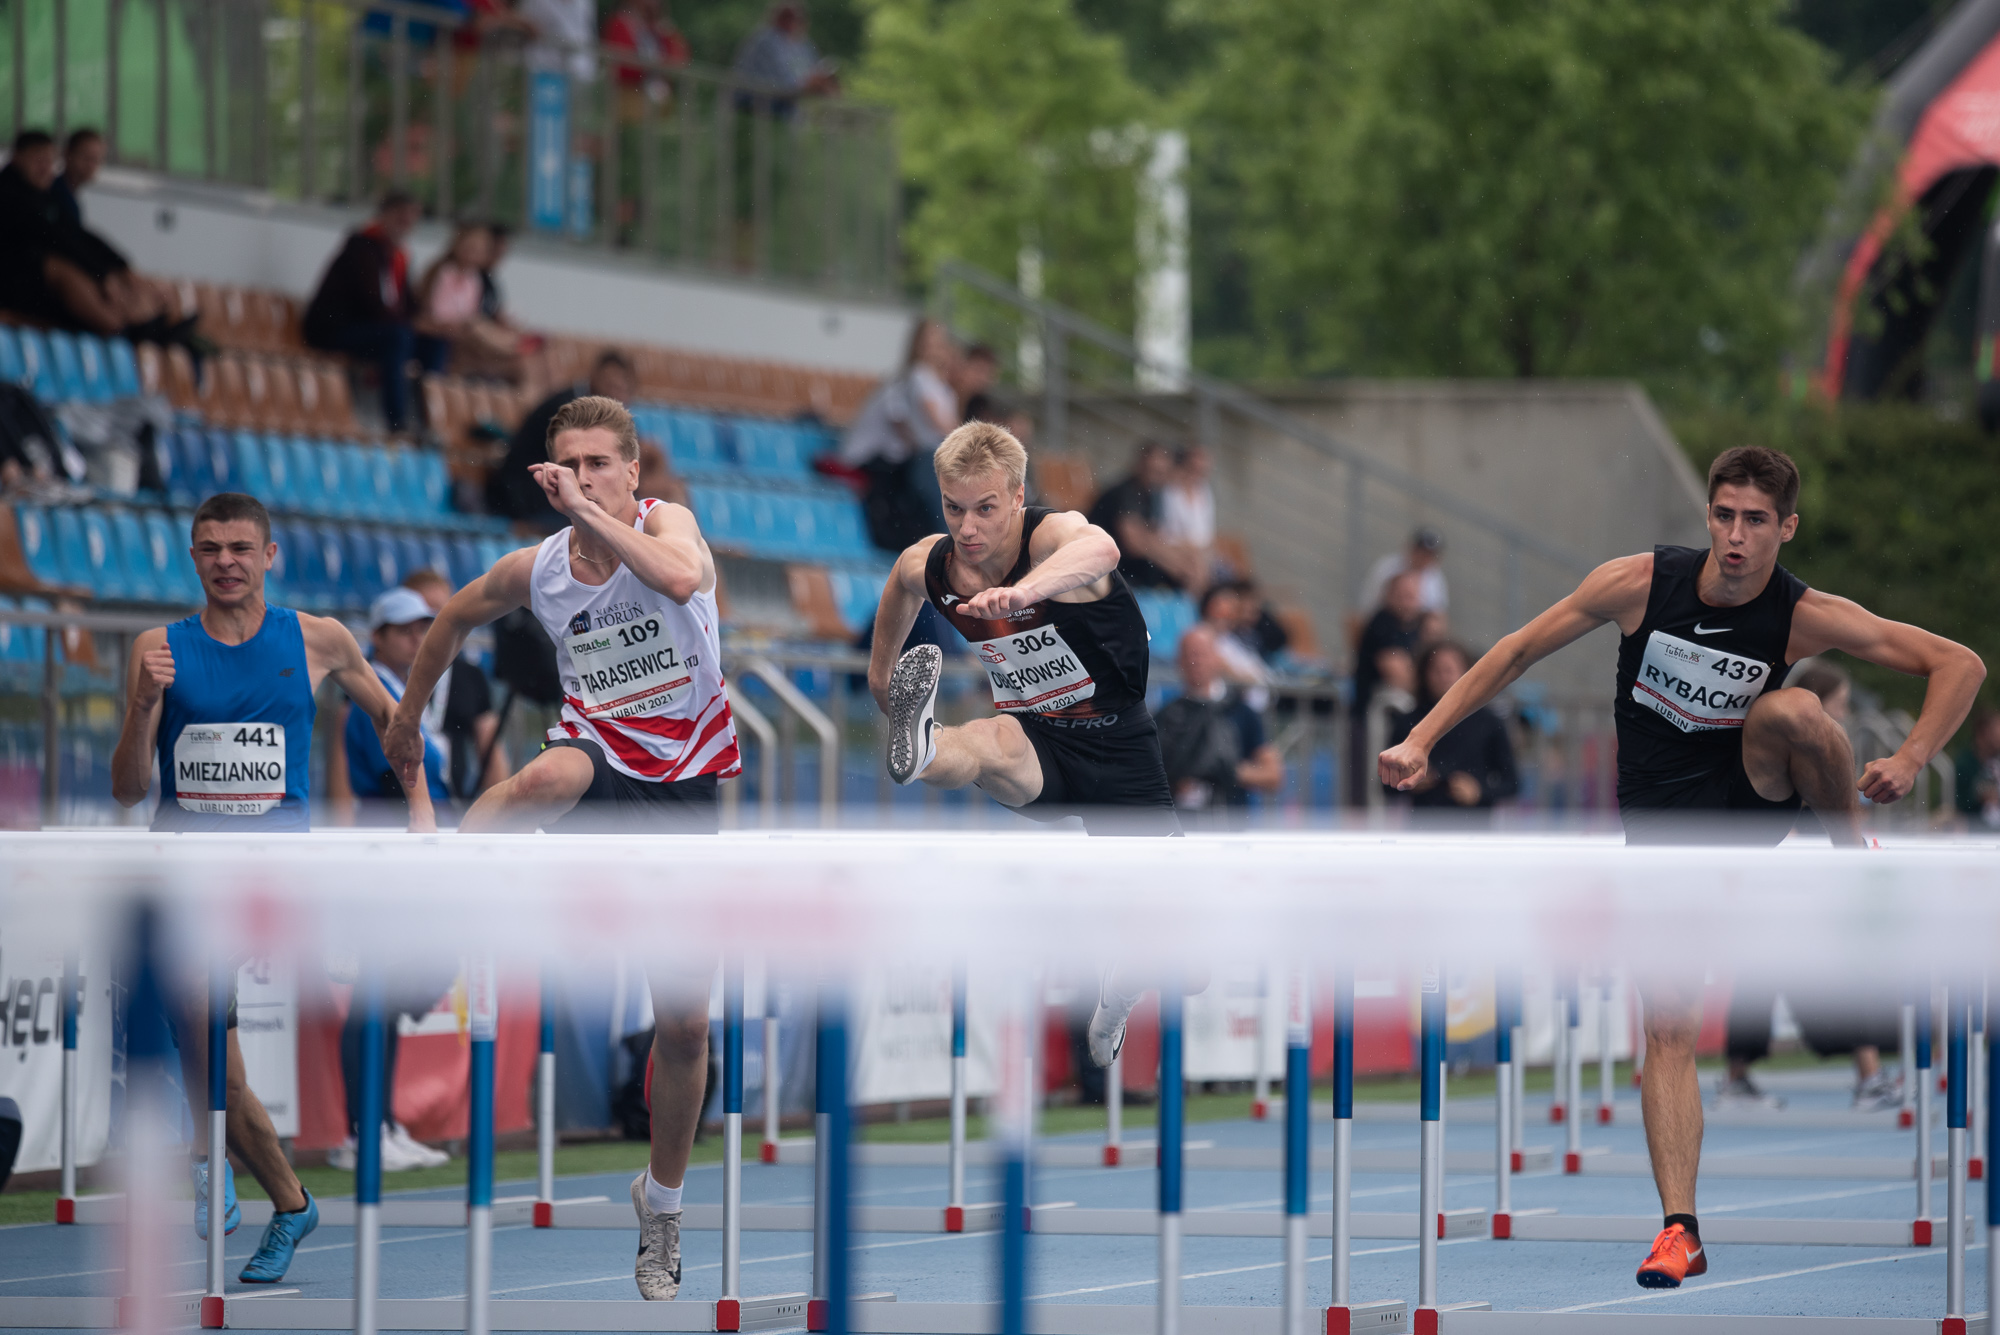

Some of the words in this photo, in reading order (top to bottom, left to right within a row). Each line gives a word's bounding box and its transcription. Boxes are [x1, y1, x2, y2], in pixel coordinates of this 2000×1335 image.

[594, 602, 645, 629] TORUŃ
[595, 602, 630, 616] MIASTO
[617, 618, 660, 648] 109
[1012, 630, 1057, 655] 306
[572, 638, 611, 654] TOTALbet
[581, 647, 680, 694] TARASIEWICZ
[1711, 657, 1763, 684] 439
[1645, 663, 1752, 710] RYBACKI
[611, 702, 647, 719] LUBLIN
[648, 693, 674, 710] 2021
[1053, 694, 1078, 709] 2021
[1070, 714, 1119, 729] PRO
[1655, 702, 1689, 730] LUBLIN
[233, 727, 279, 747] 441
[179, 761, 282, 782] MIEZIANKO
[200, 803, 234, 813] LUBLIN
[237, 803, 262, 813] 2021
